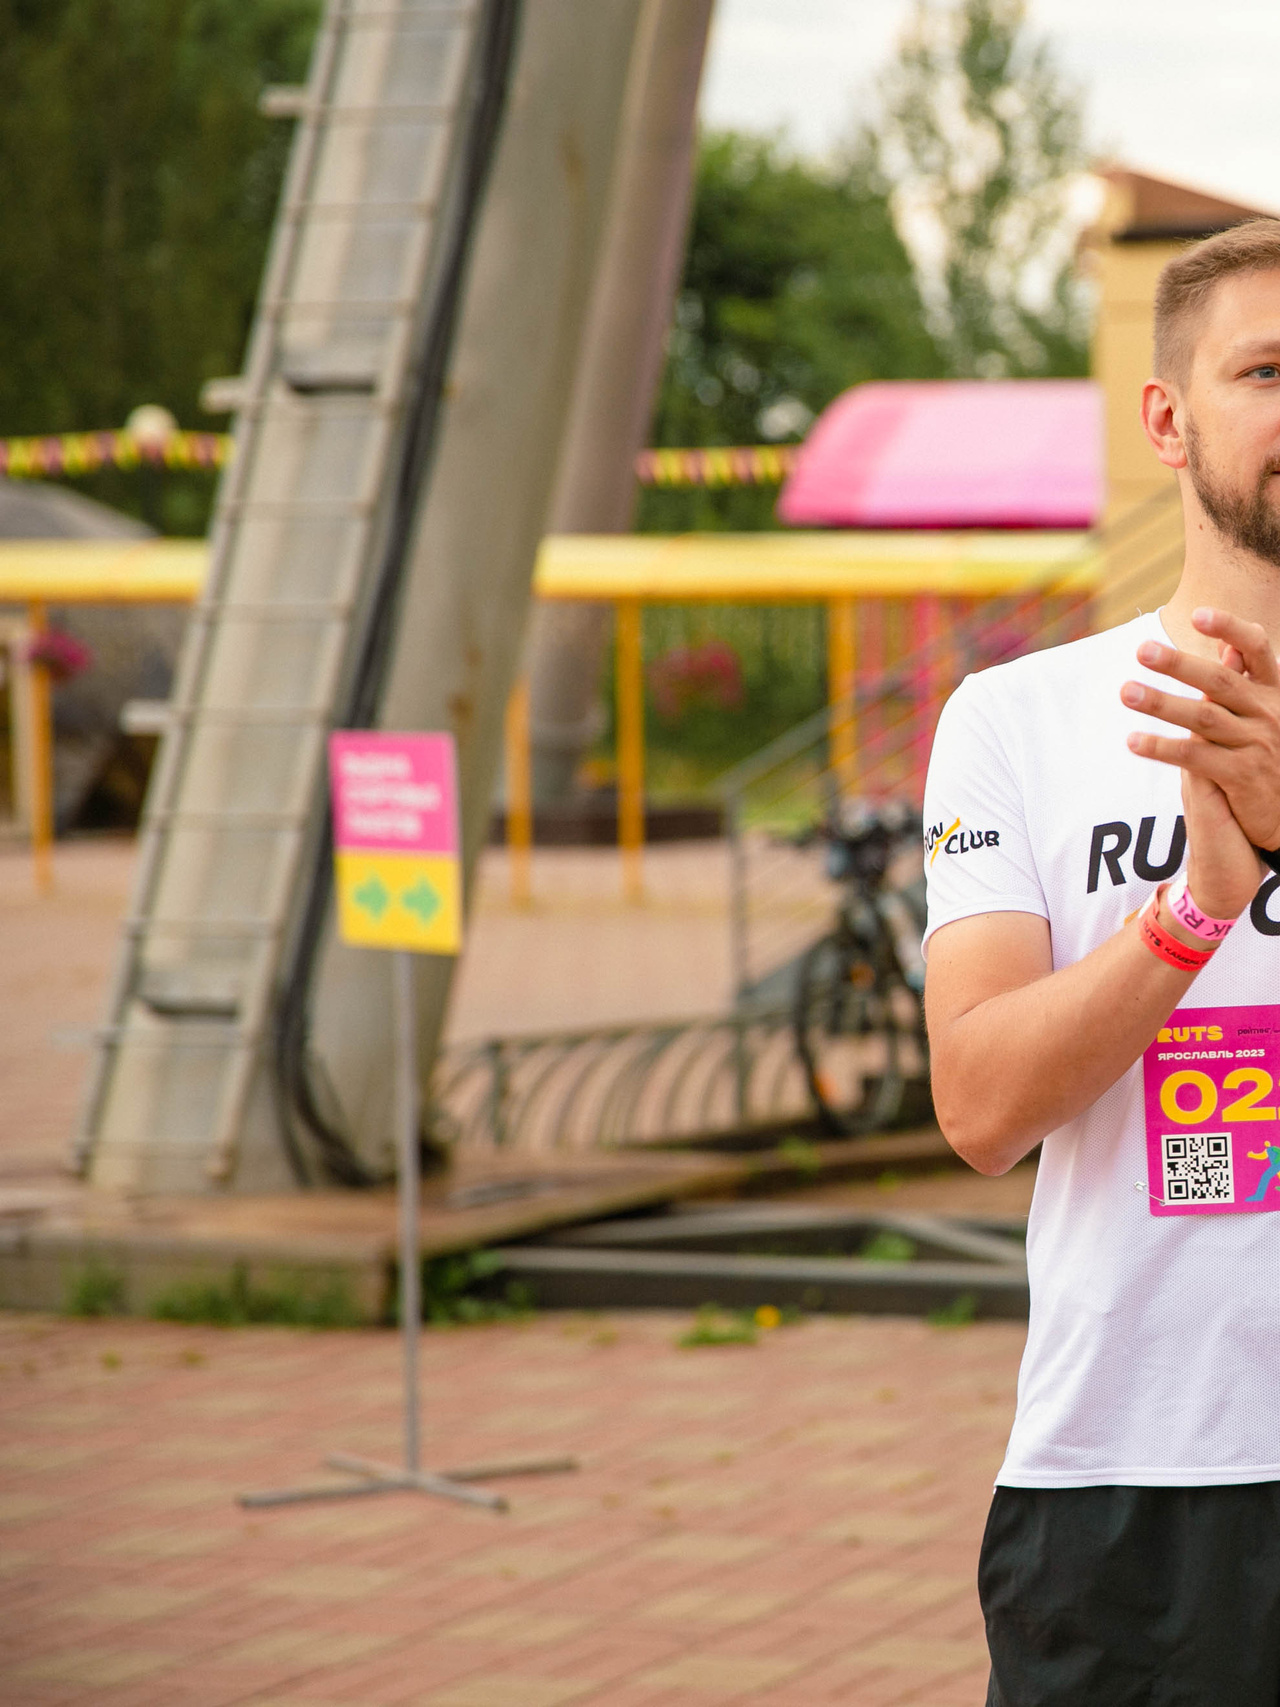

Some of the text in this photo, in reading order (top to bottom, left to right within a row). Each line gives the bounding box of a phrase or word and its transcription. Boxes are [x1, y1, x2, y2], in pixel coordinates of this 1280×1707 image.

[944, 830, 1000, 854] CLUB
[1087, 815, 1187, 894] RU
[1156, 1025, 1224, 1043] RUTS
[1157, 1049, 1265, 1061] ЯРОСЛАВЛЬ 2023
